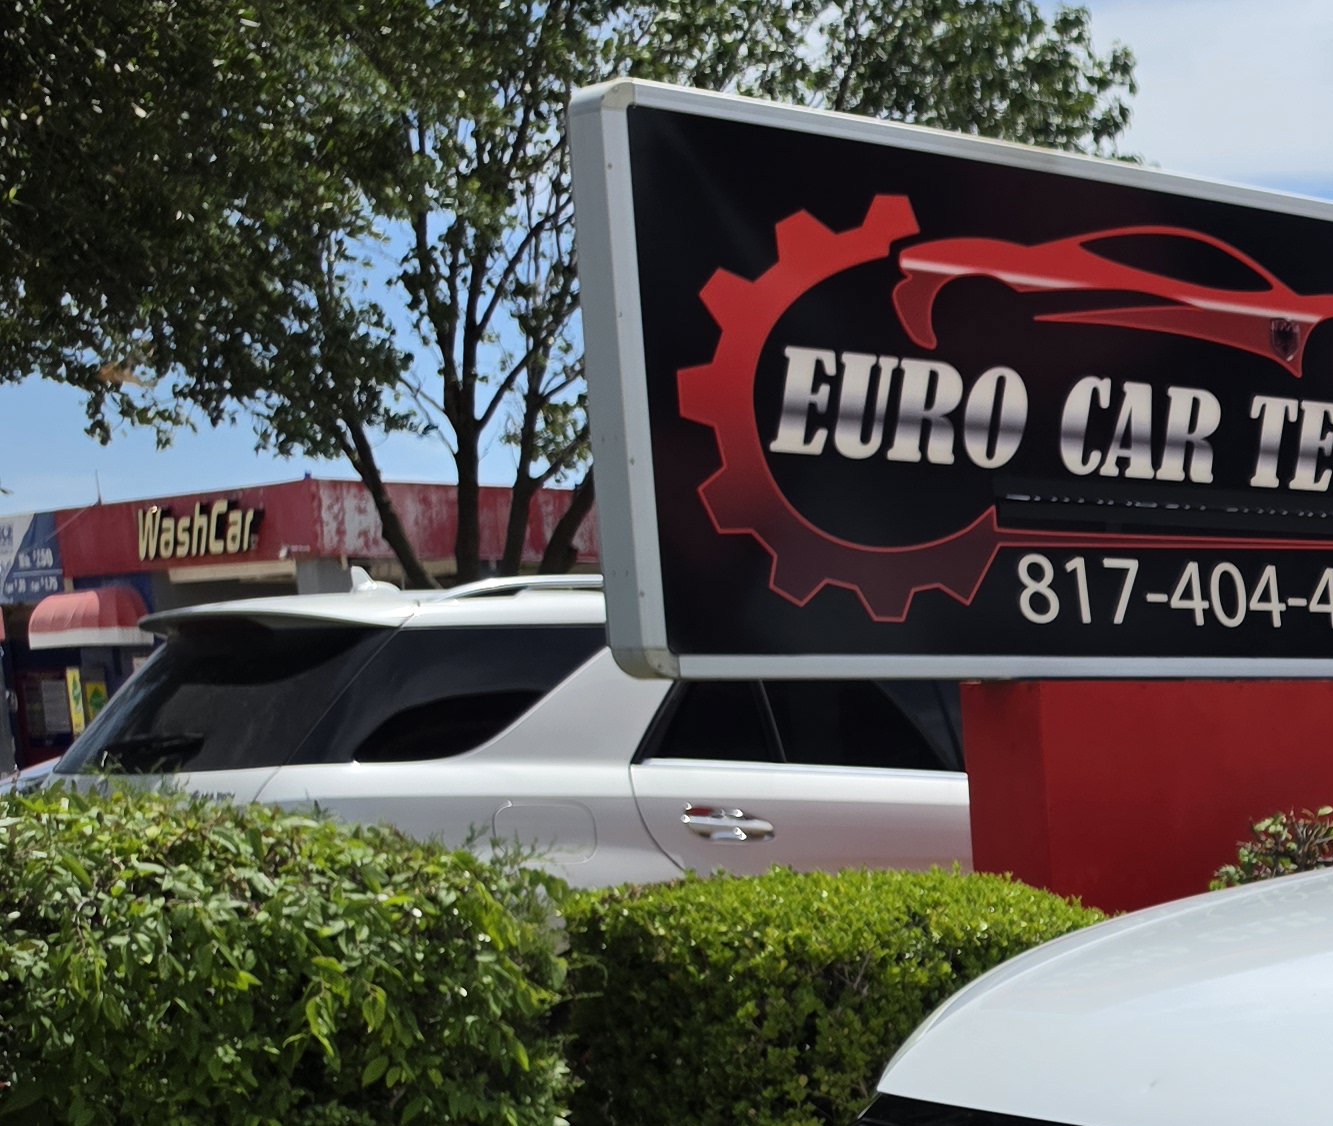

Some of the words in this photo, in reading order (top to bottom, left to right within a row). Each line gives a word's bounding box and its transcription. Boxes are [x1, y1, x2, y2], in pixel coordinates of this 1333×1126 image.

[769, 345, 1029, 470] EURO
[1060, 376, 1221, 484] CAR
[138, 499, 254, 561] WashCar
